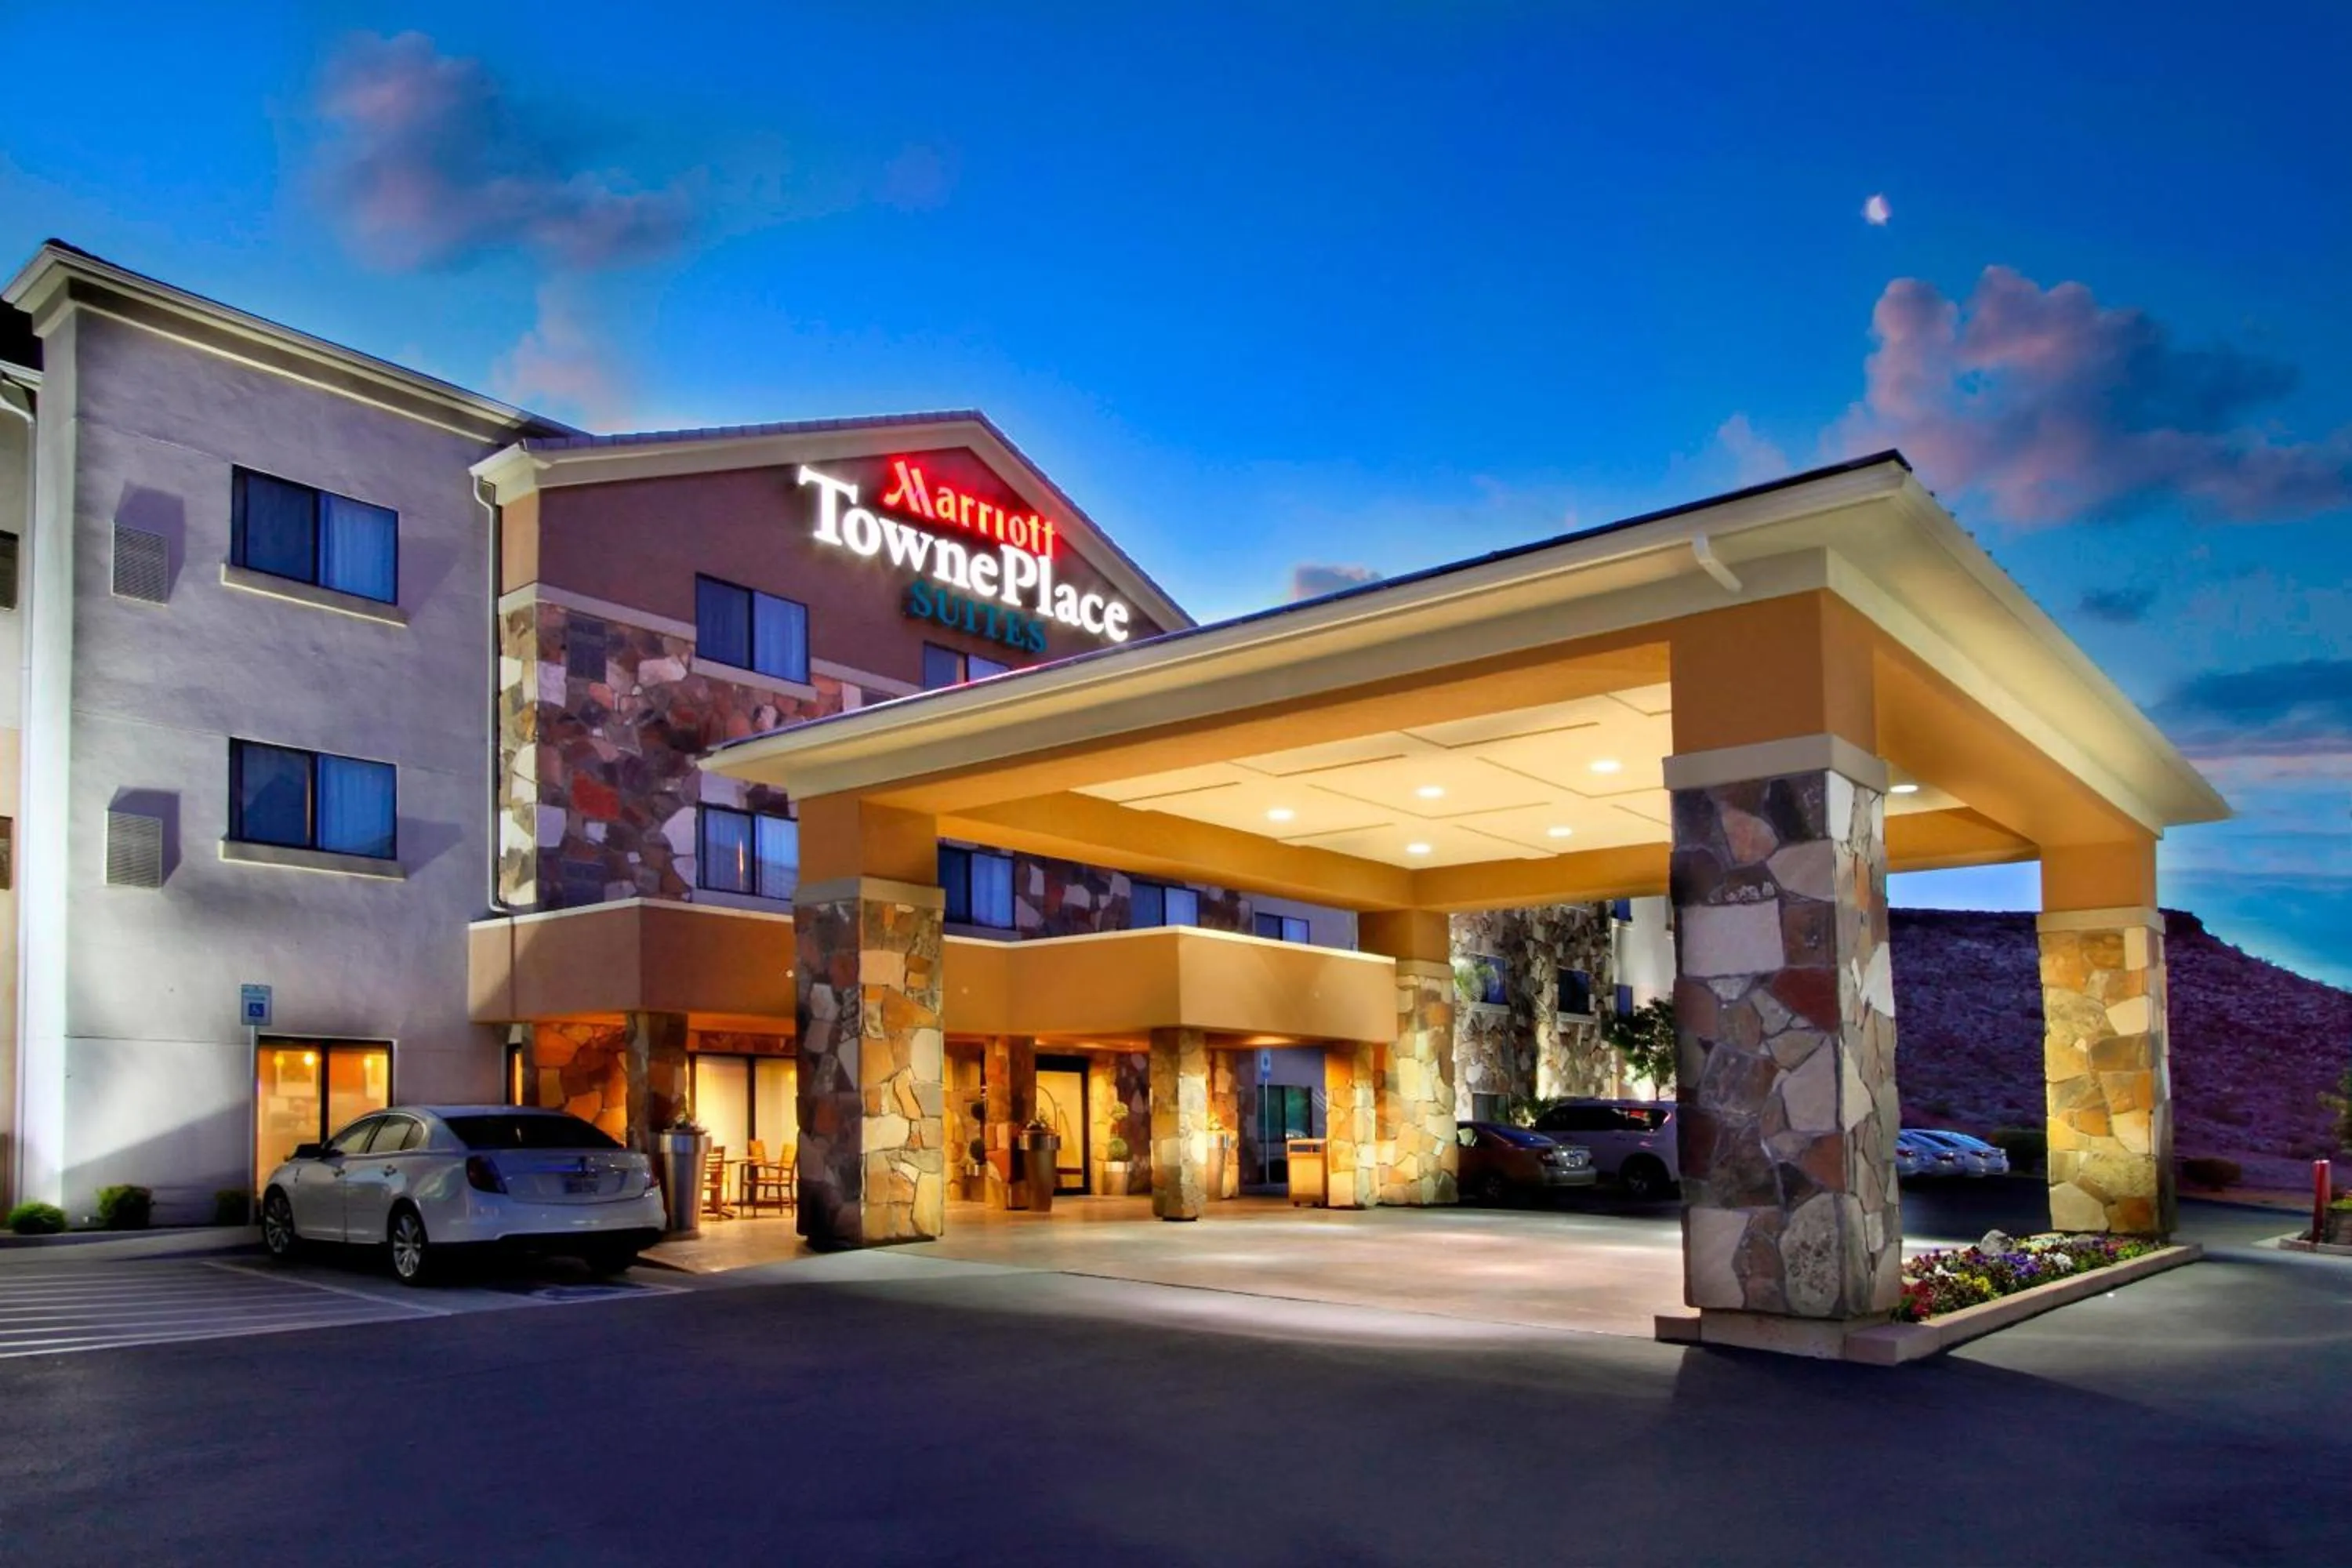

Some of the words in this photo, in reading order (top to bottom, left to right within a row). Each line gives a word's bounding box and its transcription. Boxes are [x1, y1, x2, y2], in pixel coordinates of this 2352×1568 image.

[798, 466, 1129, 642] TownePlace
[884, 459, 1055, 557] Marriott
[910, 579, 1047, 653] SUITES
